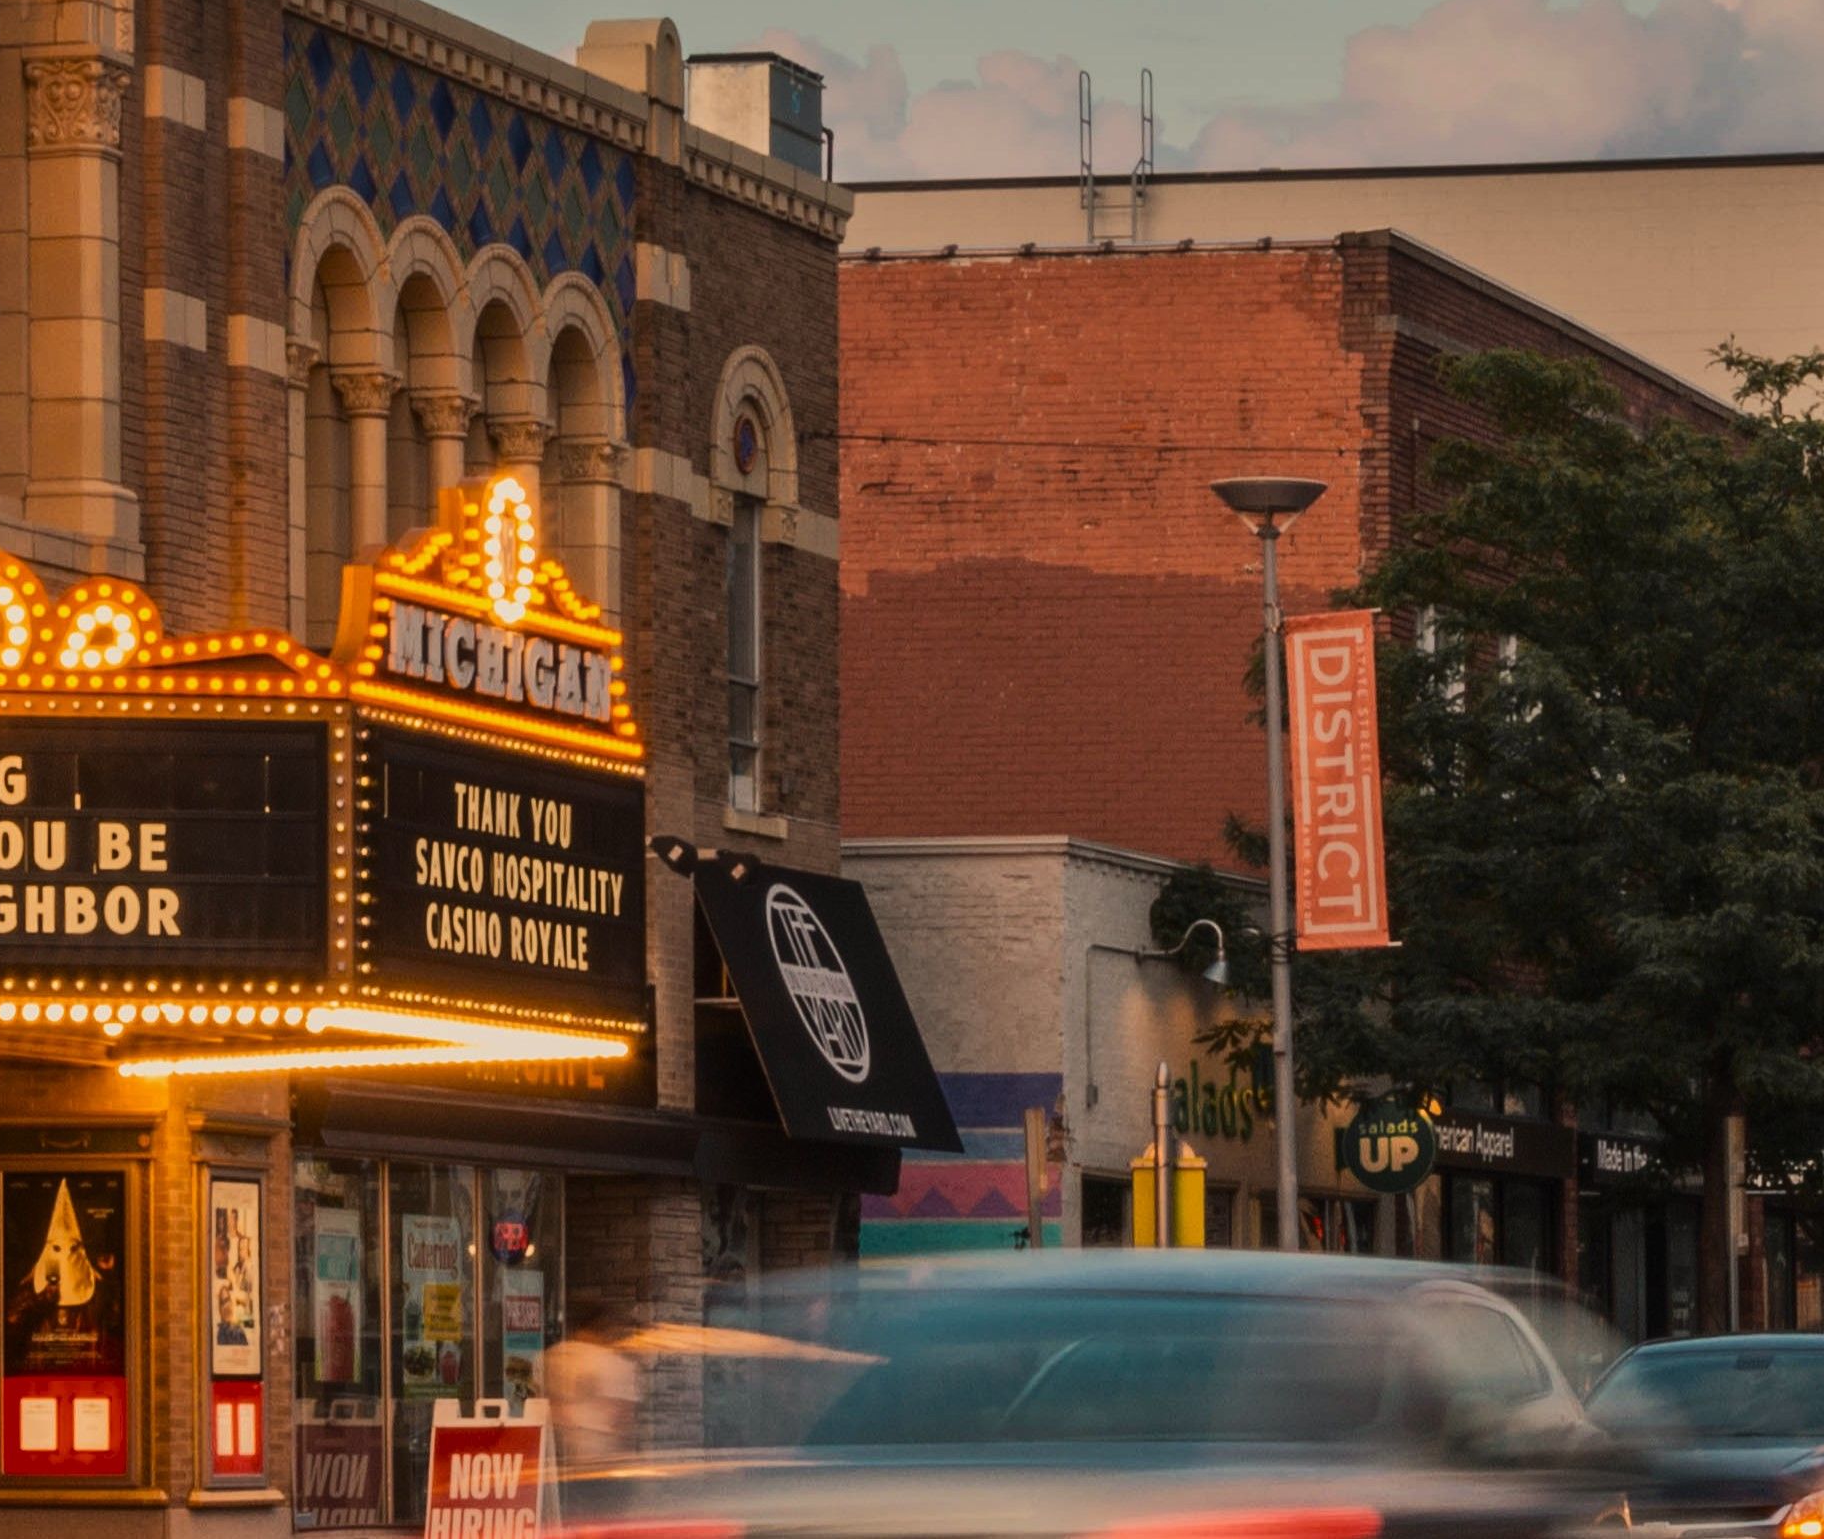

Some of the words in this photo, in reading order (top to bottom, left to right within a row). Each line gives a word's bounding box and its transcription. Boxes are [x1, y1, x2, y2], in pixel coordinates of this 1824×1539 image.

[387, 600, 612, 723] MICHIGAN
[454, 782, 521, 839] THANK
[530, 797, 572, 849] YOU
[1309, 646, 1363, 918] DISTRICT
[98, 821, 168, 872] BE
[415, 837, 484, 894] SAVCO
[492, 851, 623, 917] HOSPITALITY
[426, 901, 502, 959] CASINO
[510, 916, 589, 972] ROYALE
[794, 993, 865, 1062] YARD
[1173, 1059, 1254, 1143] alads
[1358, 1118, 1420, 1135] salads
[1359, 1135, 1420, 1174] UP
[1433, 1119, 1474, 1153] merican
[1475, 1122, 1514, 1163] Apparel
[1596, 1139, 1623, 1172] Made
[449, 1453, 524, 1500] NOW
